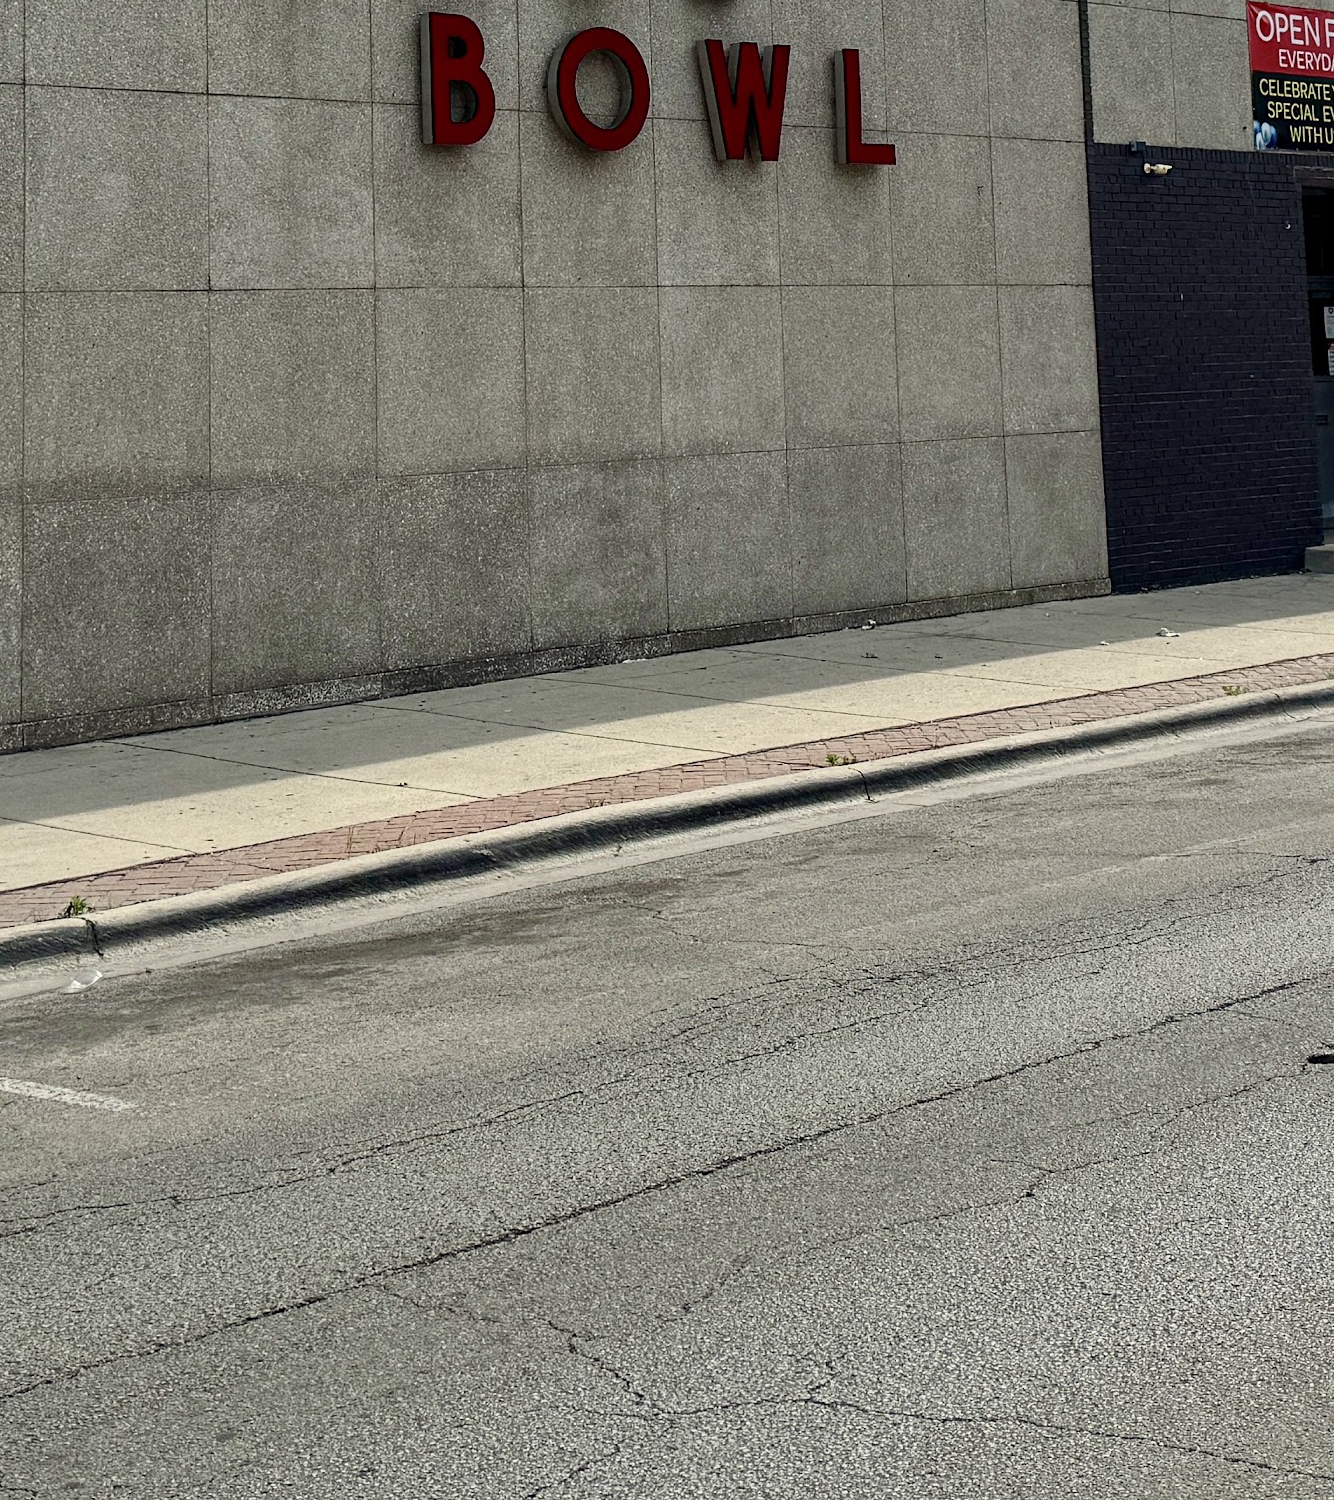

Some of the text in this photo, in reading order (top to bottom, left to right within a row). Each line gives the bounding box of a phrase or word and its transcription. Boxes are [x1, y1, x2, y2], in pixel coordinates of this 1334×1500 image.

[1255, 10, 1321, 47] OPEN
[420, 11, 897, 166] BOWL
[1259, 78, 1331, 101] CELEBRATE
[1267, 101, 1320, 122] SPECIAL
[1289, 124, 1323, 144] WITH
